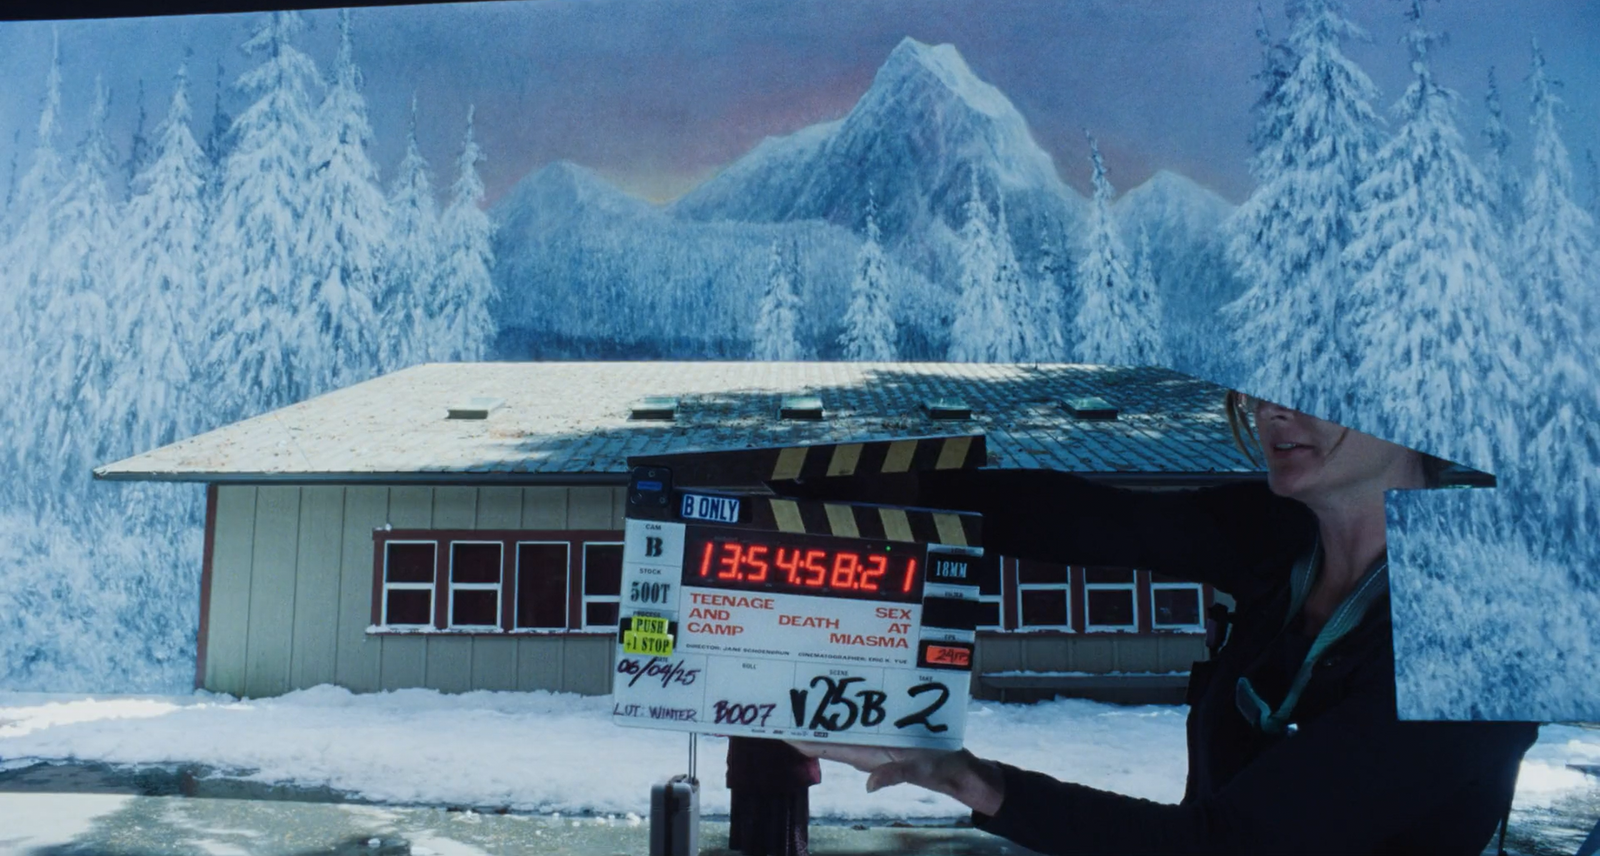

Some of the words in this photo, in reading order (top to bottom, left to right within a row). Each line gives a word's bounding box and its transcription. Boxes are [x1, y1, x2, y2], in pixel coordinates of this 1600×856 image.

[684, 495, 694, 516] B
[700, 497, 738, 521] ONLY
[645, 536, 663, 557] B
[936, 560, 968, 578] 18MM
[631, 581, 670, 604] 500T
[690, 592, 775, 610] TEENAGE
[875, 607, 912, 620] SEX
[636, 618, 664, 634] PUSH
[688, 607, 730, 621] AND
[778, 614, 840, 629] DEATH
[888, 622, 911, 634] AT
[626, 636, 638, 651] +1
[641, 637, 670, 653] STOP
[686, 621, 744, 636] CAMP
[829, 633, 909, 649] MIASMA
[617, 656, 701, 688] 06/04/25
[828, 669, 848, 677] SCENE
[648, 701, 697, 723] WINTER
[713, 699, 777, 728] B007
[893, 682, 950, 733] 2
